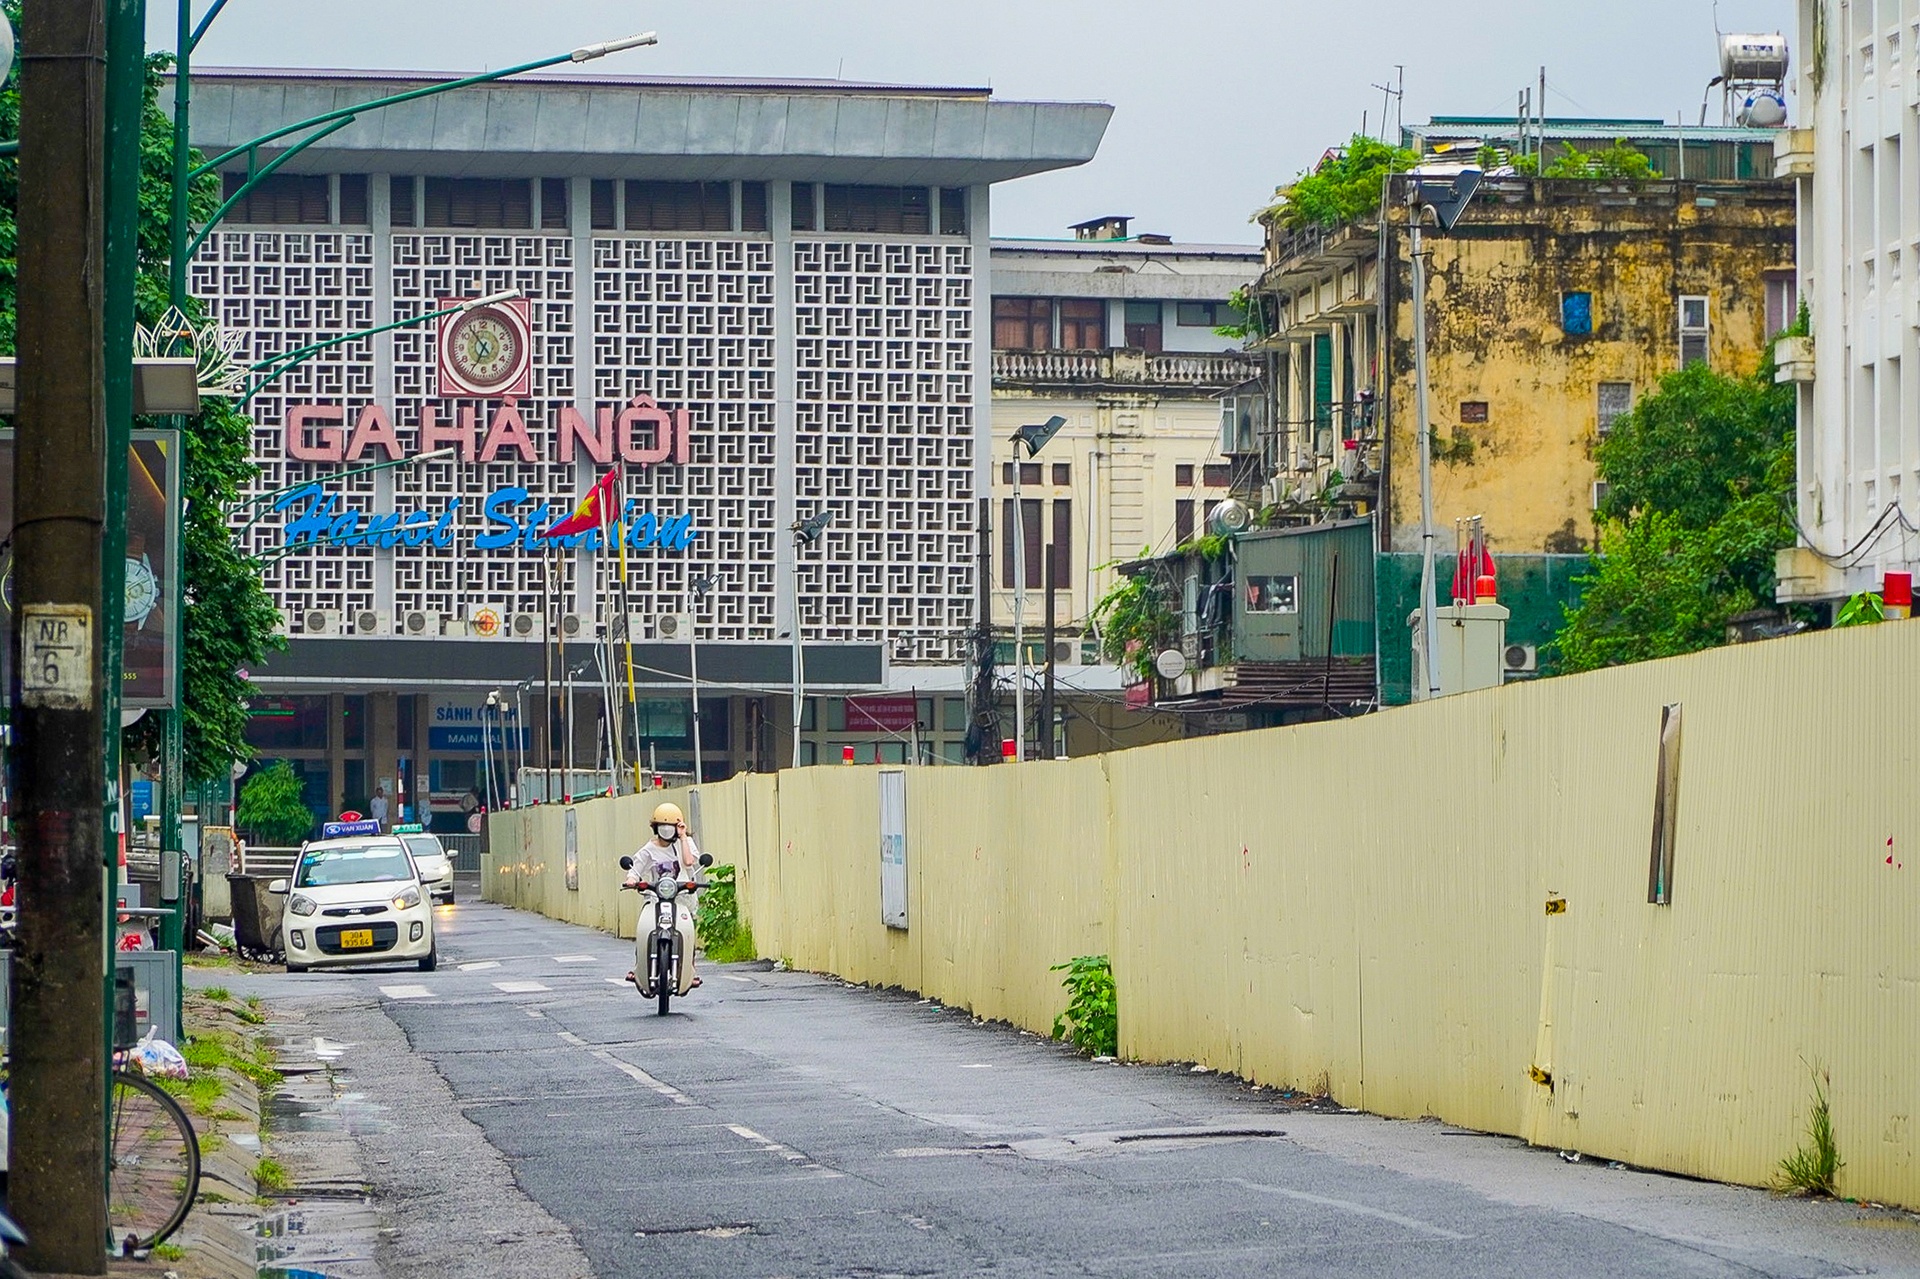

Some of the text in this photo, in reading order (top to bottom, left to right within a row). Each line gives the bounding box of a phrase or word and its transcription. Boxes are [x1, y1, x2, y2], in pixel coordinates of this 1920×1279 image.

[479, 321, 487, 329] 12
[480, 366, 487, 374] 6
[287, 393, 690, 469] GA HÀ NỘI
[274, 483, 460, 549] Hanoi
[43, 651, 59, 684] 6
[436, 701, 472, 720] SẢNH
[448, 734, 477, 743] MAIN
